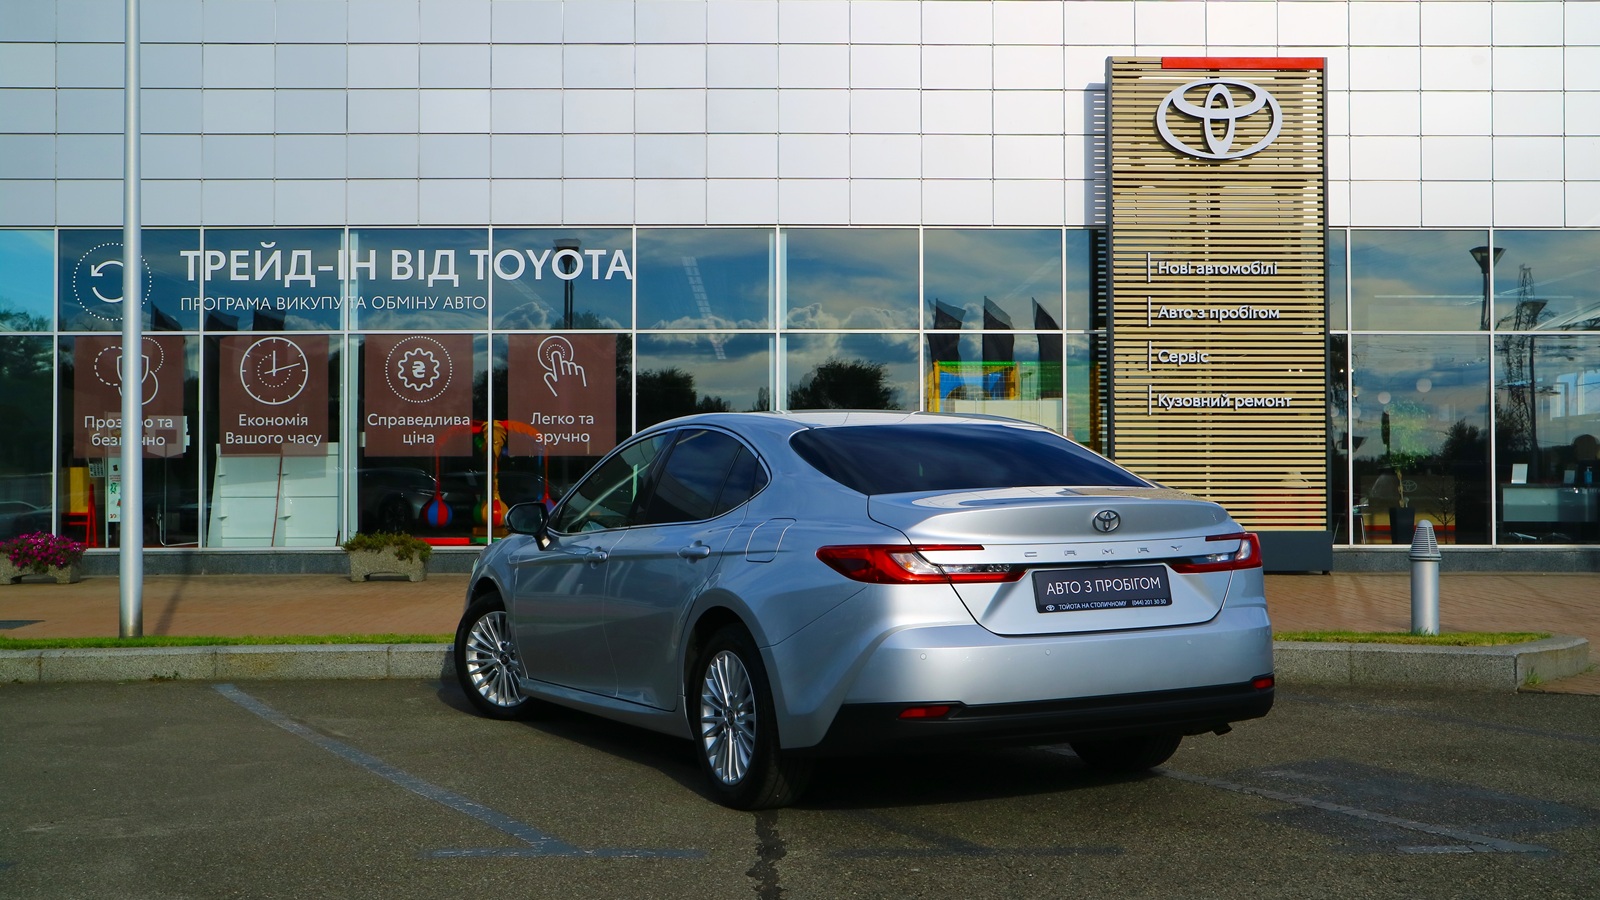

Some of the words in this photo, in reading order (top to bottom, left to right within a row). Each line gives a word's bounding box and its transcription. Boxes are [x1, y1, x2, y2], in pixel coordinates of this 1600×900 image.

[179, 241, 376, 288] ТРЕЙД-ІН
[391, 249, 459, 288] ВІД
[469, 248, 633, 281] TOYOTA
[1157, 261, 1192, 275] Нові
[1196, 261, 1278, 275] автомобілі
[180, 297, 271, 311] ПРОГРАМА
[276, 296, 344, 311] ВИКУПУ
[348, 296, 367, 310] ТА
[371, 296, 440, 310] ОБМІНУ
[443, 296, 487, 310] АВТО
[1157, 305, 1194, 319] Авто
[1197, 308, 1206, 319] з
[1209, 305, 1280, 322] пробігом
[1157, 350, 1209, 366] Сервіс
[1157, 394, 1231, 411] Кузовний
[1235, 397, 1292, 410] ремонт
[84, 416, 154, 431] Прозо
[157, 418, 173, 428] та
[238, 413, 309, 427] Економія
[367, 413, 471, 429] Справедлива
[530, 412, 575, 425] Легко
[579, 415, 595, 425] та
[91, 432, 166, 447] безно
[225, 432, 284, 445] Вашого
[287, 434, 322, 447] часу
[402, 432, 435, 446] ціна
[535, 432, 590, 445] зручно
[1023, 544, 1183, 558] CAMRY
[1046, 580, 1081, 596] АВТО
[1095, 576, 1161, 592] ПРОБІГОМ
[1058, 603, 1081, 611] ТОЙОТА
